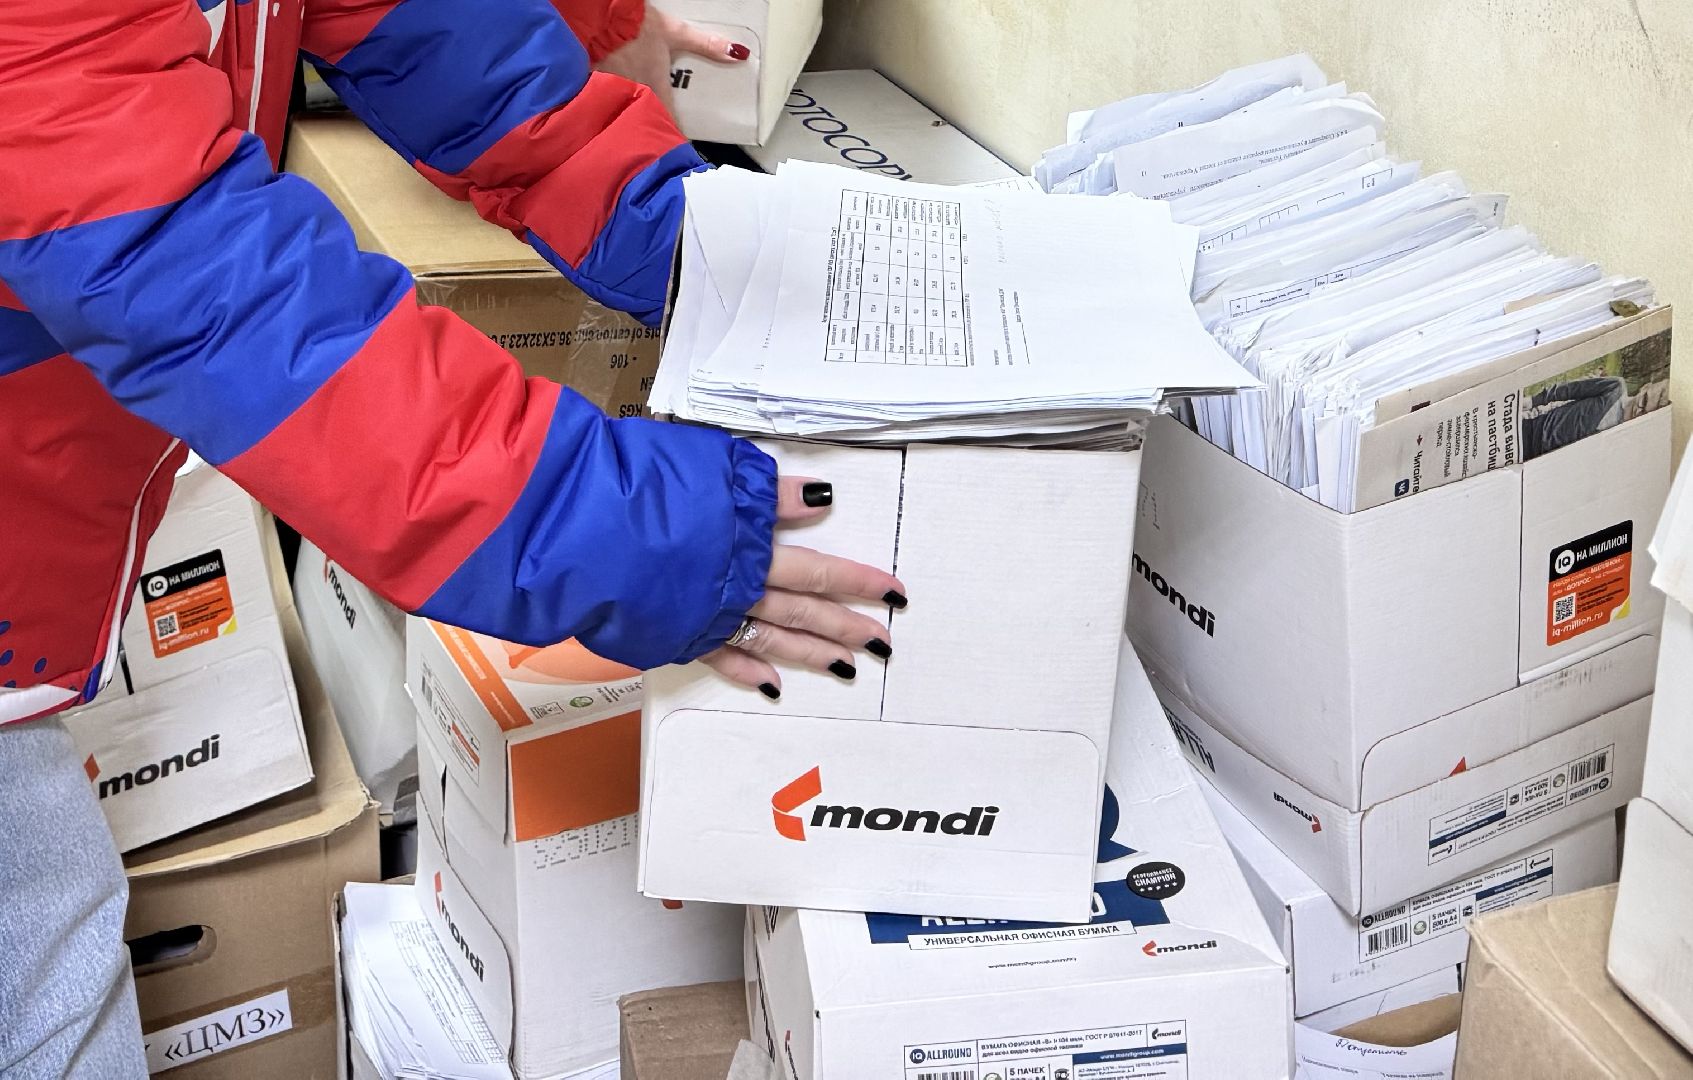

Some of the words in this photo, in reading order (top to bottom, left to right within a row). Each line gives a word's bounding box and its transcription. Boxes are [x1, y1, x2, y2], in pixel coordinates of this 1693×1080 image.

[785, 89, 912, 180] OTOCOP
[611, 354, 628, 368] 106
[619, 403, 643, 418] KGS
[1487, 400, 1496, 417] на
[1503, 393, 1516, 432] Стада
[1412, 450, 1423, 493] Читайте
[1577, 549, 1588, 562] НА
[1589, 533, 1628, 557] МИЛЛИОН
[169, 574, 181, 586] НА
[181, 560, 220, 581] МИЛЛИОН
[1132, 552, 1216, 638] mondi
[1552, 611, 1603, 637] iq-million.ru
[98, 733, 221, 801] mondi
[1273, 790, 1313, 823] mondi
[810, 804, 1000, 837] mondi
[1132, 867, 1174, 880] PERFORMANCE
[1134, 872, 1177, 888] CHAMPION
[441, 899, 485, 982] mondi
[923, 932, 1020, 947] УНИВЕРСАЛЬНАЯ
[1021, 928, 1076, 942] ОФИСНАЯ
[1077, 923, 1120, 937] БУМАГА
[1156, 939, 1218, 954] mondi
[165, 1007, 285, 1061] «ЦМЗ»
[1085, 1033, 1103, 1041] ГОСТ
[926, 1047, 972, 1061] ALLROUND
[1009, 1068, 1015, 1076] 5
[1017, 1066, 1045, 1075] ПАЧЕК
